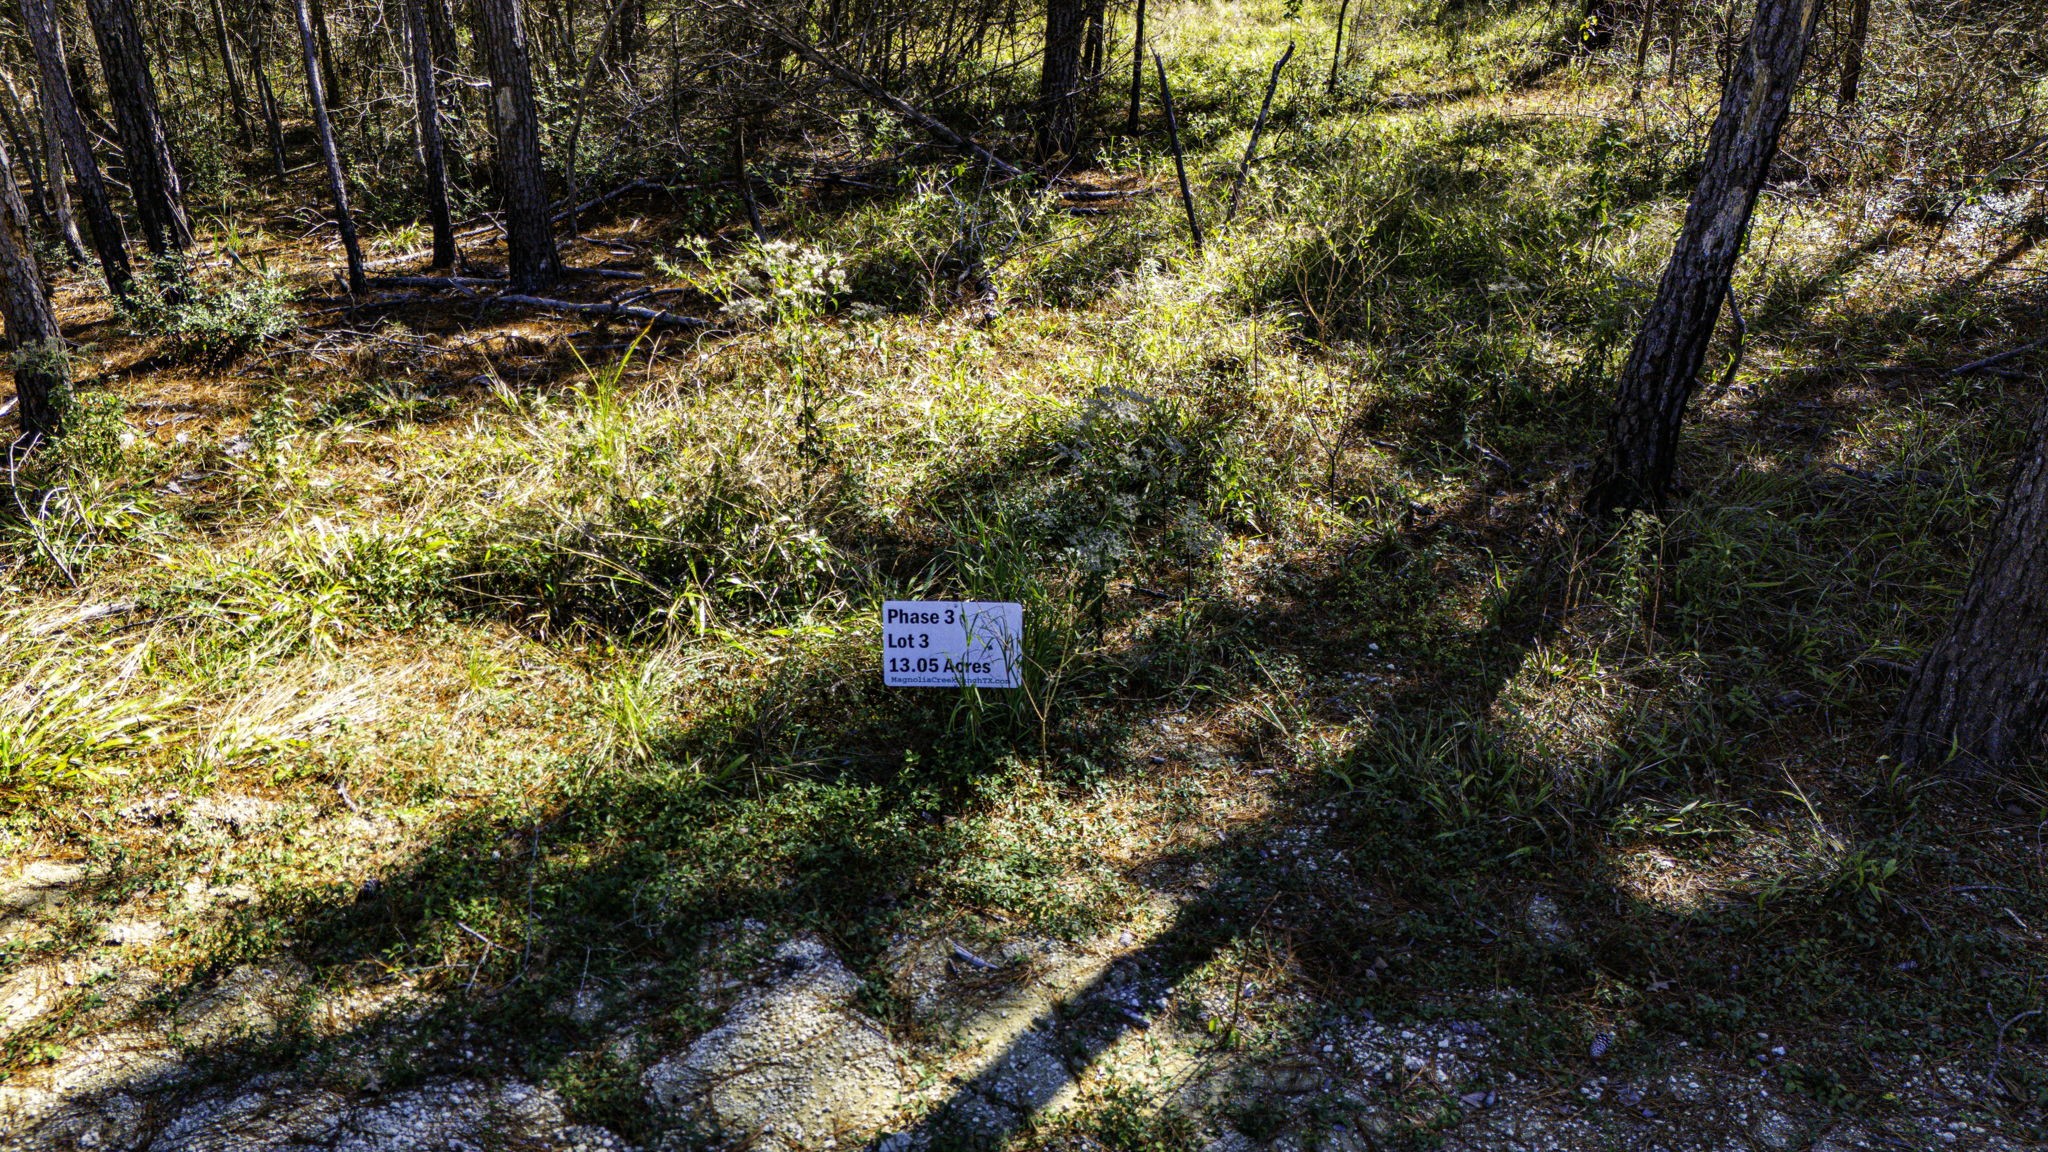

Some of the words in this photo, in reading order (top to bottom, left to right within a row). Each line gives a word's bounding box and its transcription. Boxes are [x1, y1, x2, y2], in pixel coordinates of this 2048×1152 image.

[887, 608, 940, 625] Phase
[944, 609, 955, 625] 3
[888, 634, 915, 649] Lot
[918, 633, 930, 649] 3
[889, 657, 939, 673] 13.05
[943, 658, 991, 674] Acres
